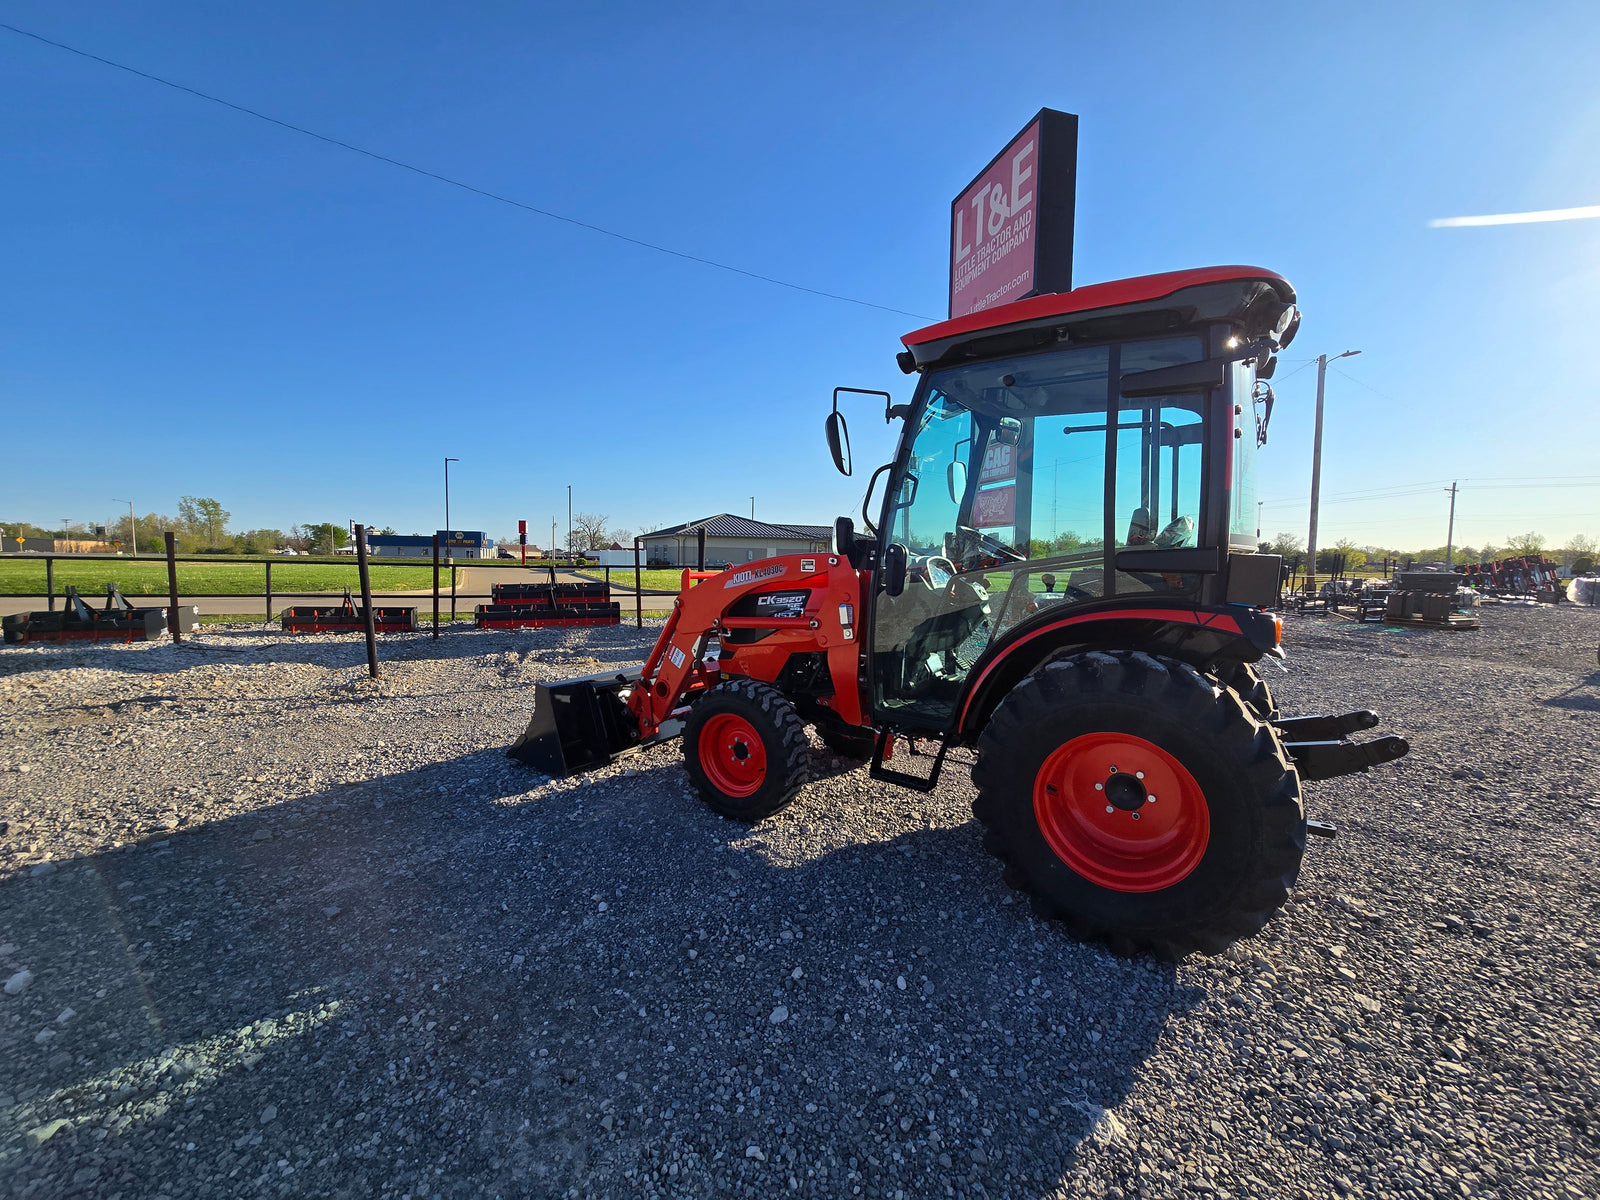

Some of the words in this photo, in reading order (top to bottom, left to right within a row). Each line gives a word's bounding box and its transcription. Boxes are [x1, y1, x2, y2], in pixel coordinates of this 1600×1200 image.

[956, 140, 1033, 264] LT&E
[955, 254, 976, 282] LITTLE
[977, 225, 1011, 263] TRACTOR
[1013, 209, 1032, 235] AND
[955, 256, 991, 295] EQUIPMENT
[992, 225, 1031, 264] COMPANY
[963, 270, 1030, 316] LittleTractor.com
[983, 445, 1011, 470] CAG
[733, 570, 752, 584] KIOTI
